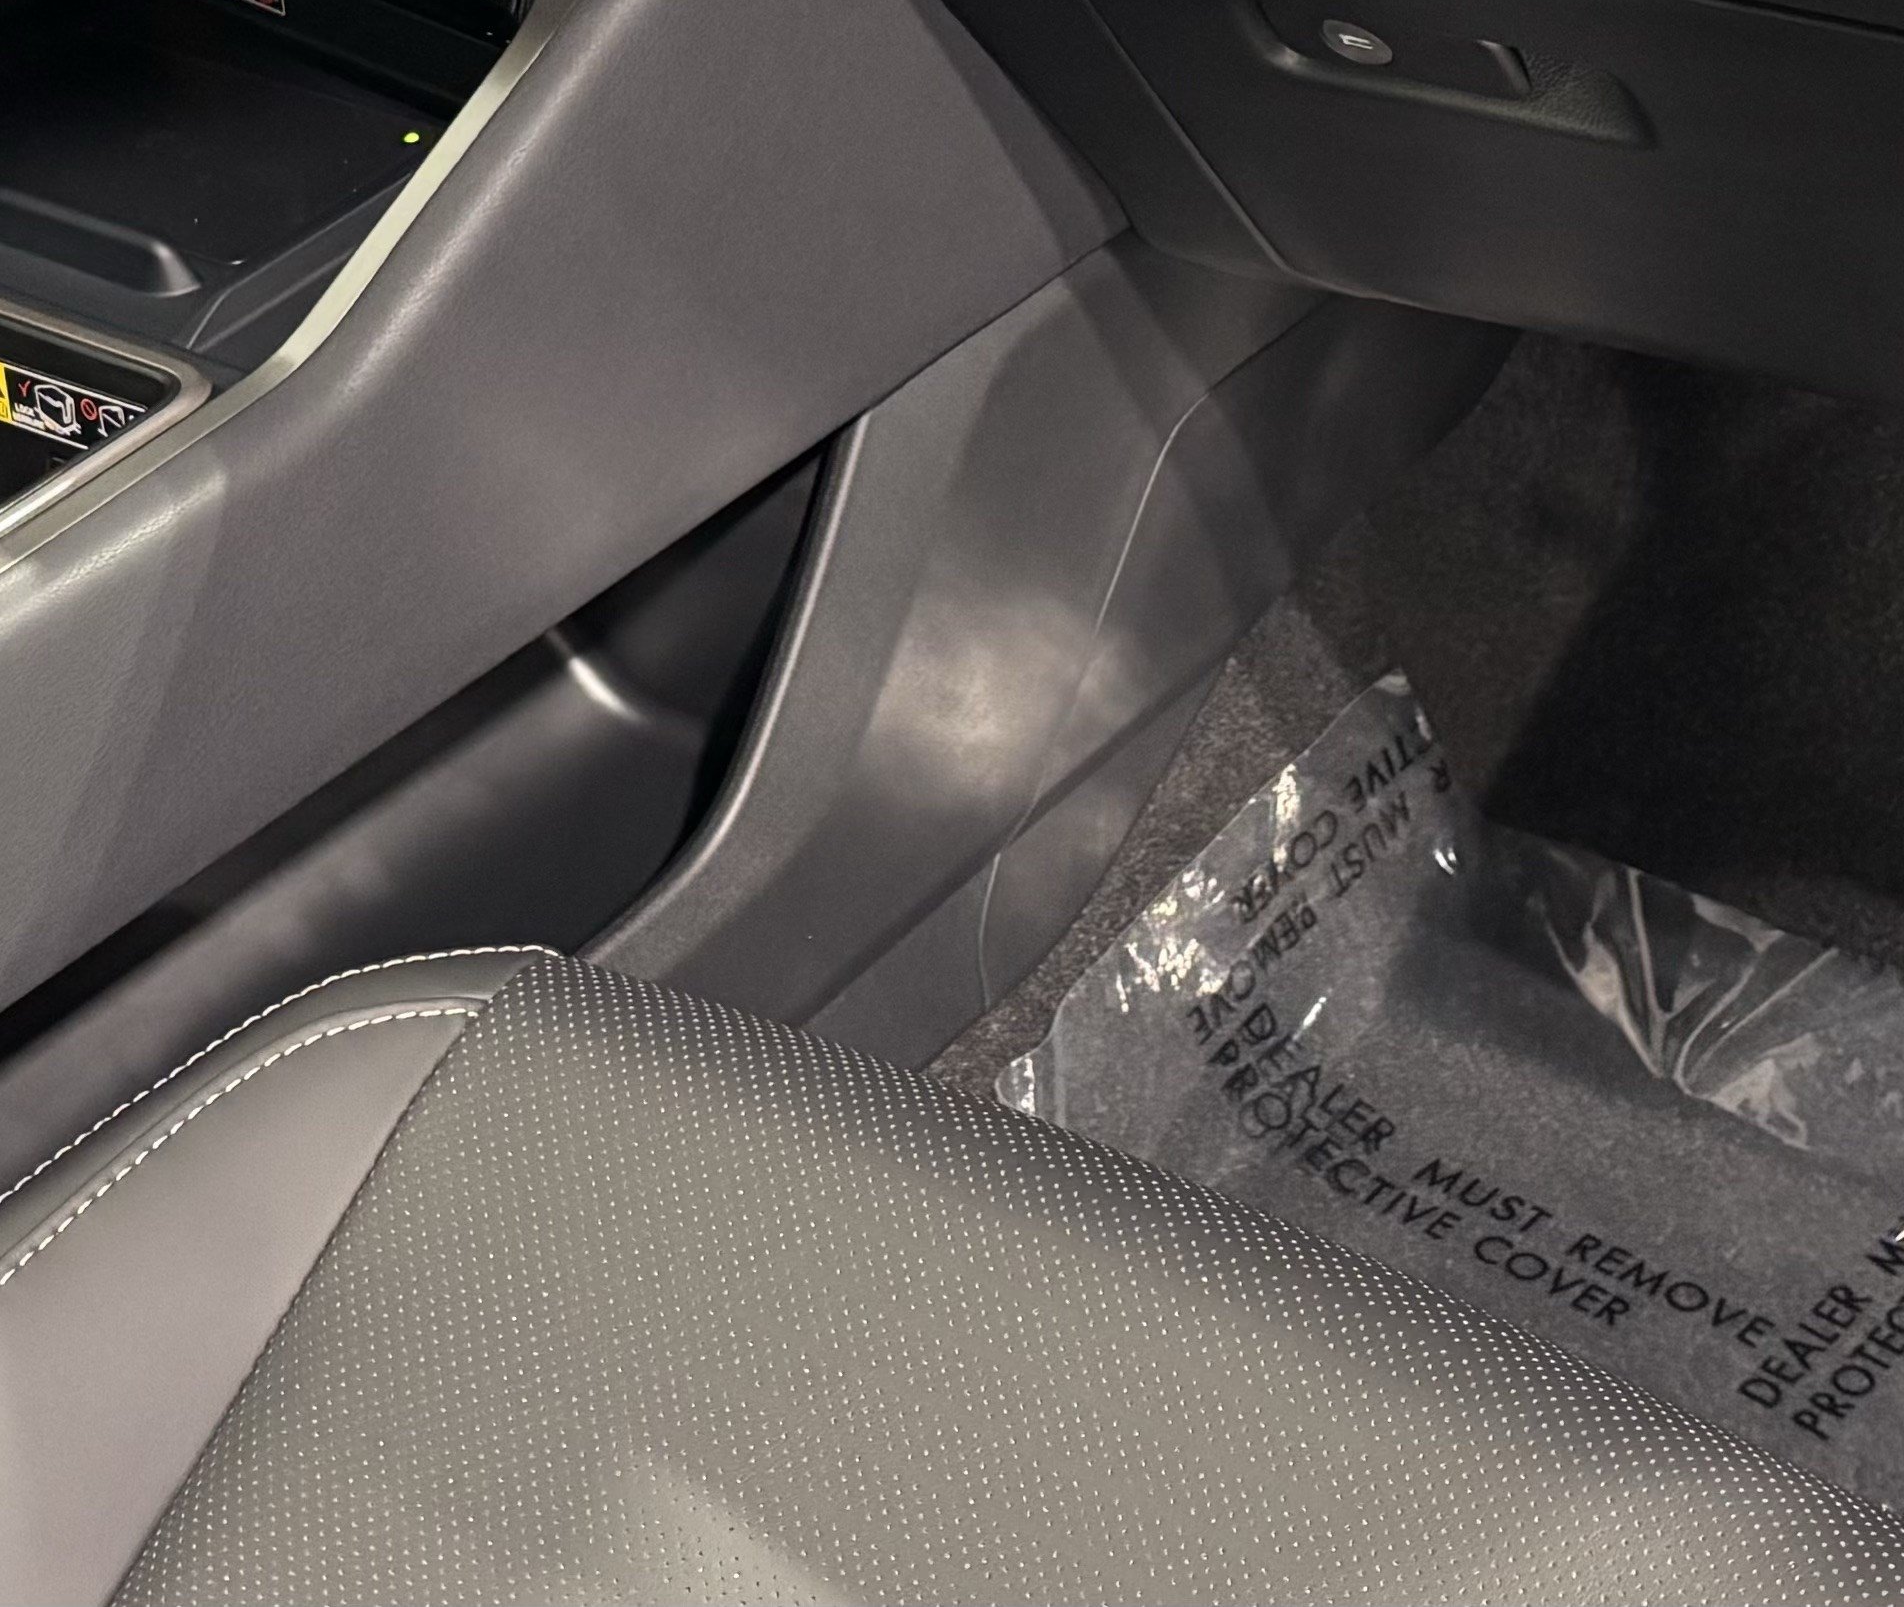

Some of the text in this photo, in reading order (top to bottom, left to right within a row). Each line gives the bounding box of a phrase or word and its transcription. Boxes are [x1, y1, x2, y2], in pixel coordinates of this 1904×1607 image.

[1186, 790, 1412, 1045] MUST REMOVE
[1206, 1039, 1630, 1326] PROTECTIVE COVER
[1237, 1002, 1776, 1348] DEALER MUST REMOVE
[1738, 1284, 1873, 1409] DEALER
